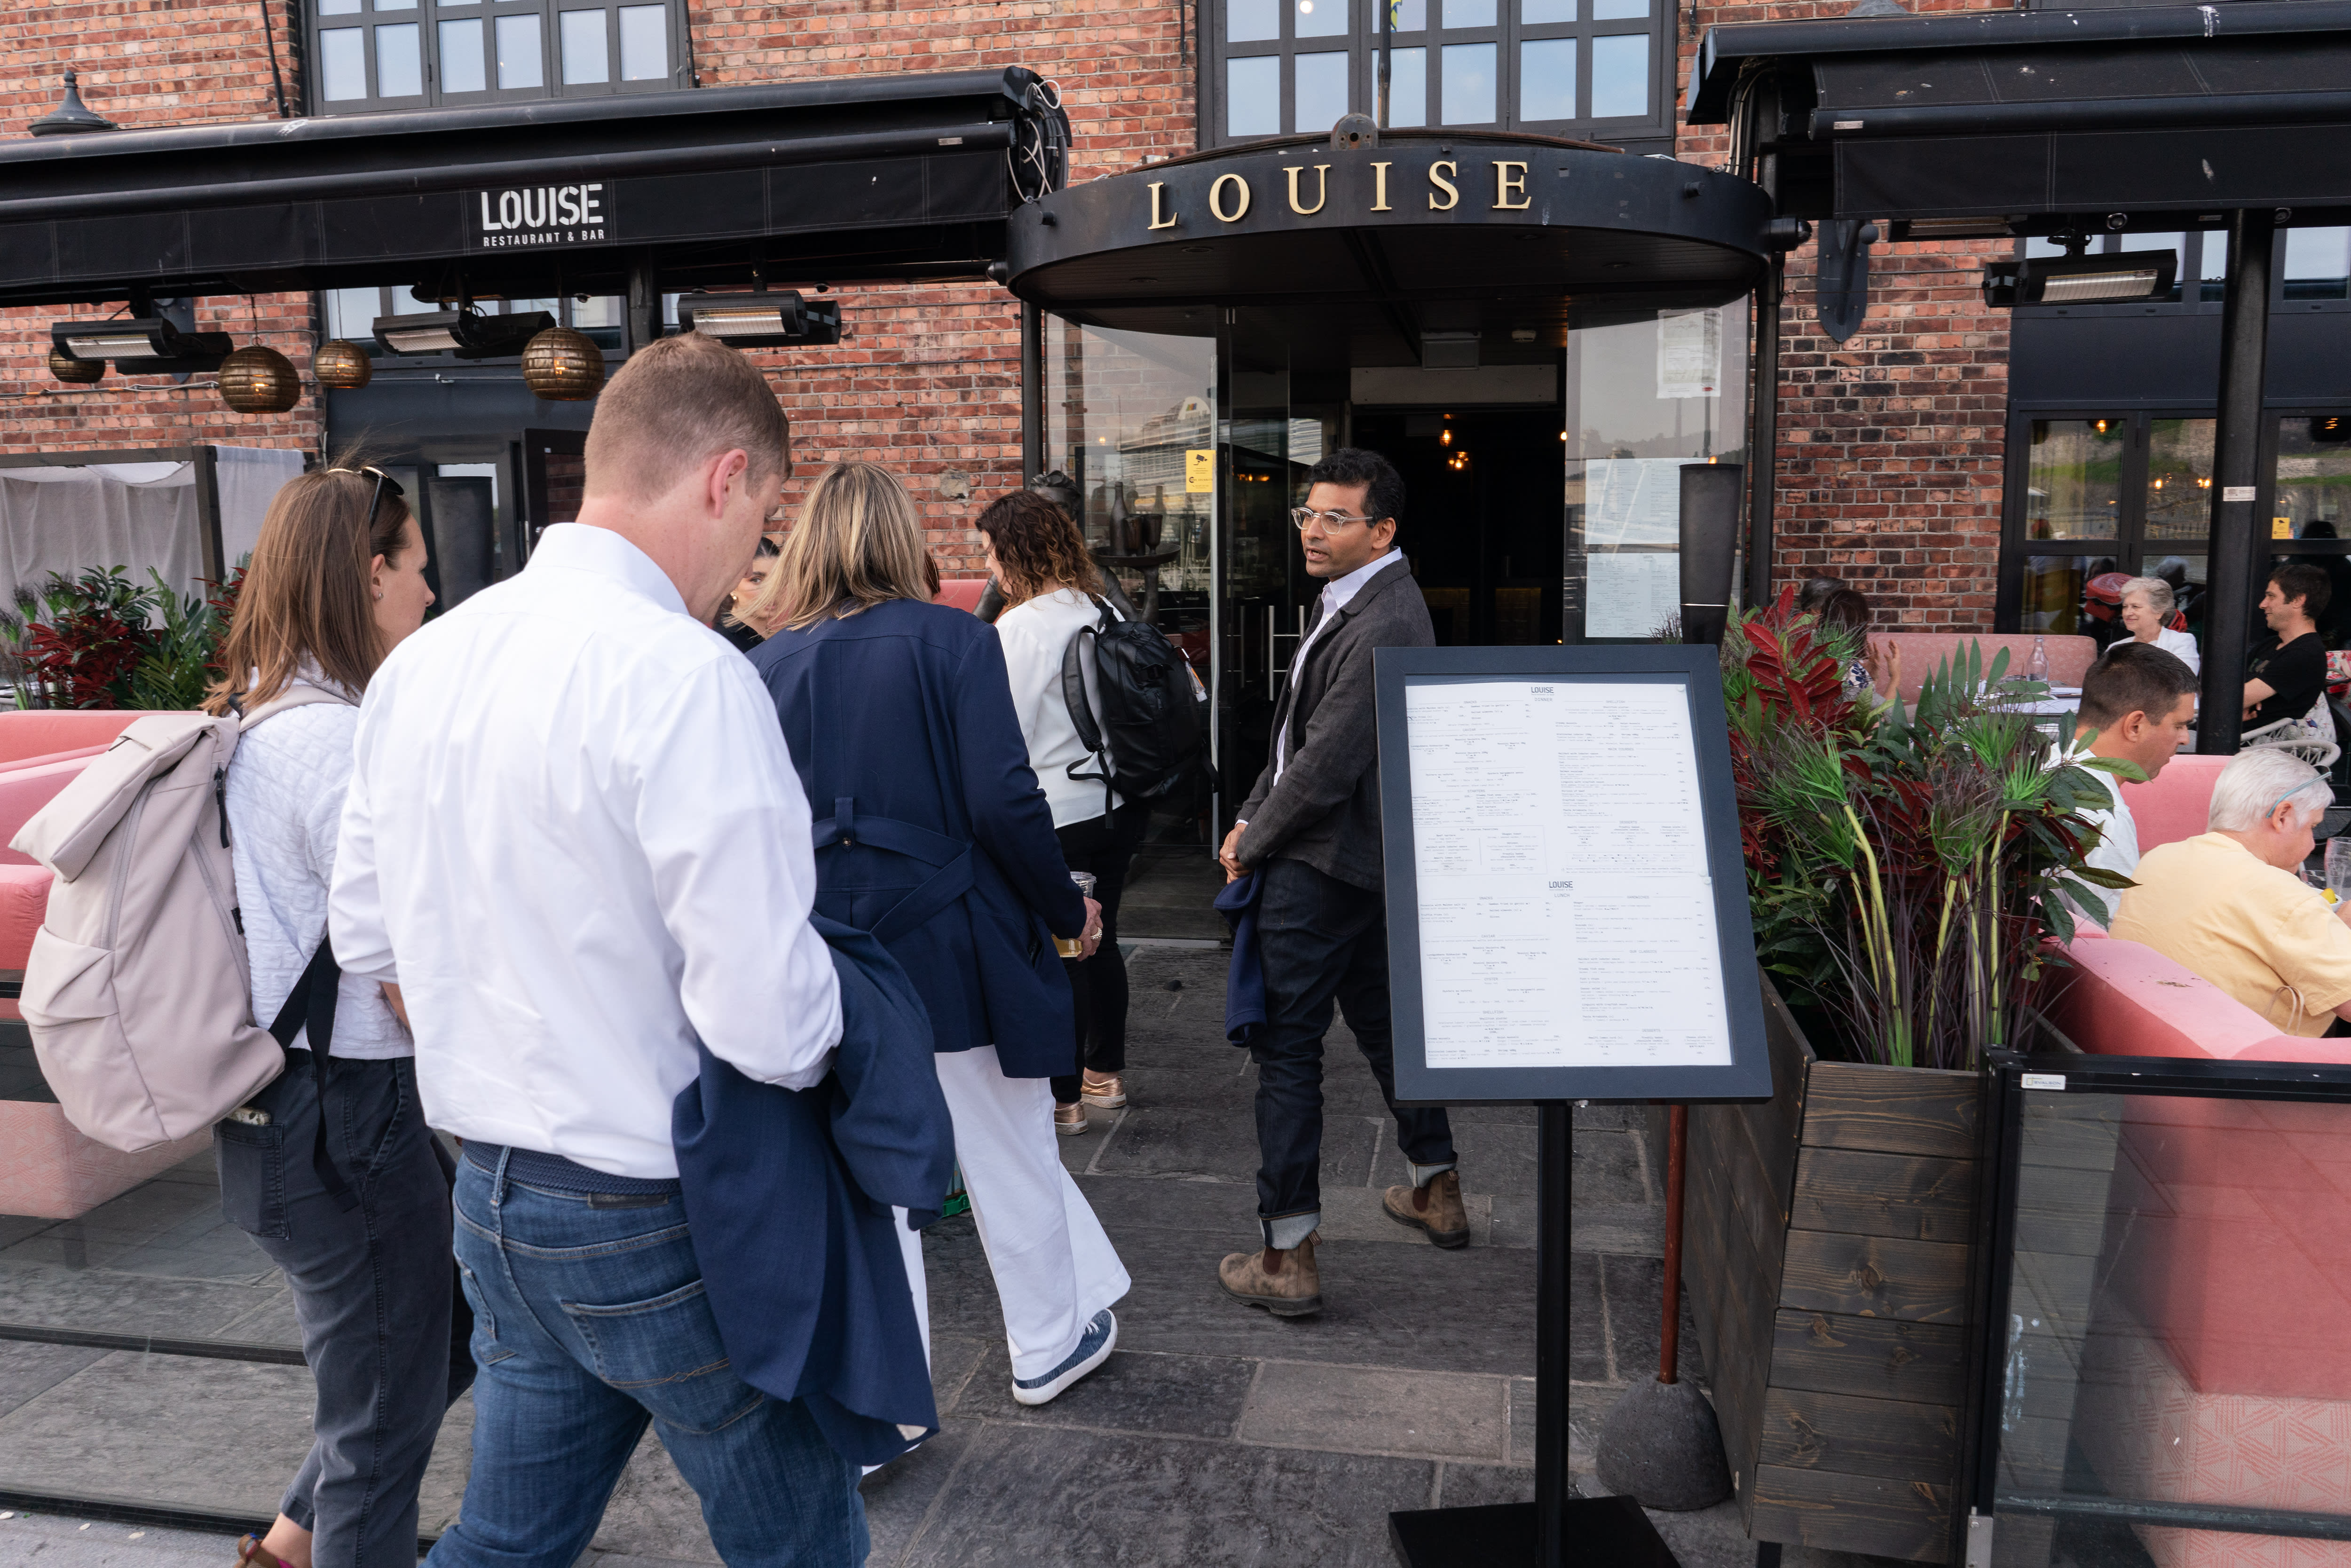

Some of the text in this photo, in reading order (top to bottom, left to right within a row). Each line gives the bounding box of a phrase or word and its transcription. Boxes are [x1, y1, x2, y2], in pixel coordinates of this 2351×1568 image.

[481, 184, 604, 230] LOUISE
[1147, 161, 1531, 230] LOUISE
[483, 229, 604, 247] RESTAURANT & BAR
